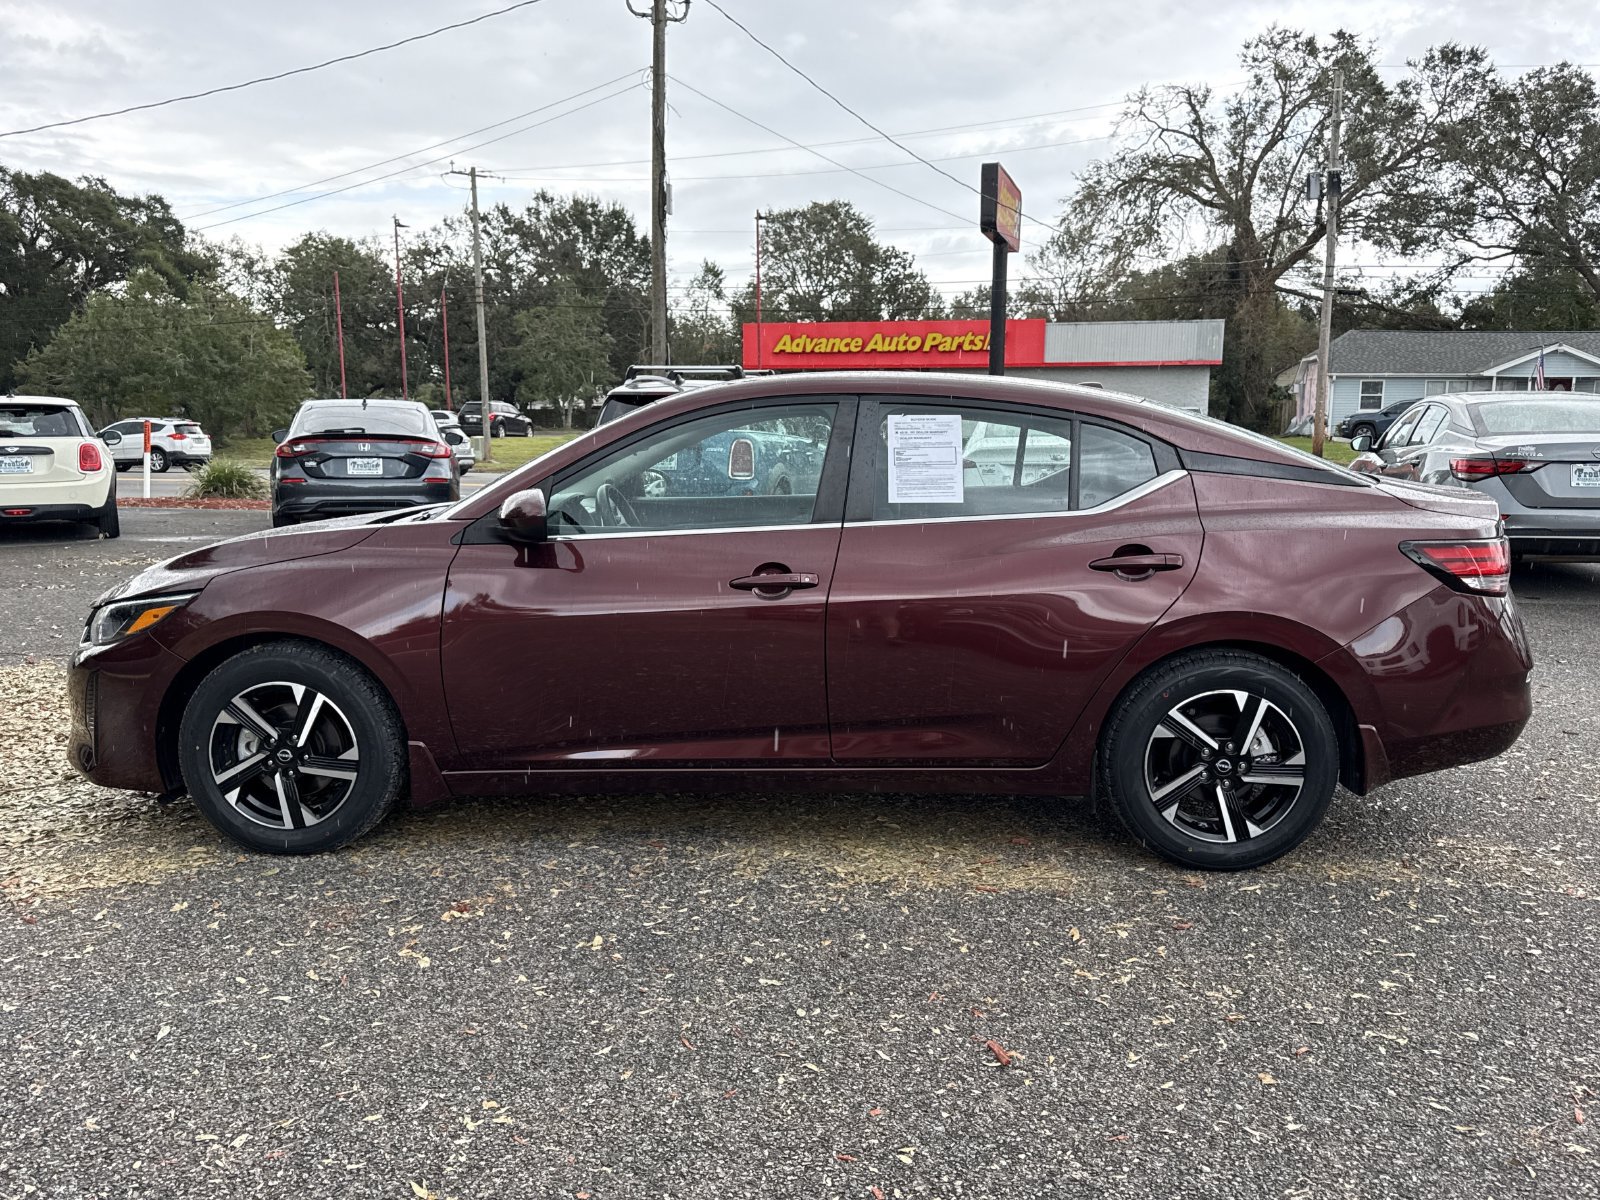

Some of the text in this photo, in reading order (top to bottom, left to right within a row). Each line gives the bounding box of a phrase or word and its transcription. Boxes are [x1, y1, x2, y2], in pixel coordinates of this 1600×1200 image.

[773, 334, 863, 353] Advance
[864, 332, 922, 352] Auto
[1574, 467, 1600, 478] Fron
